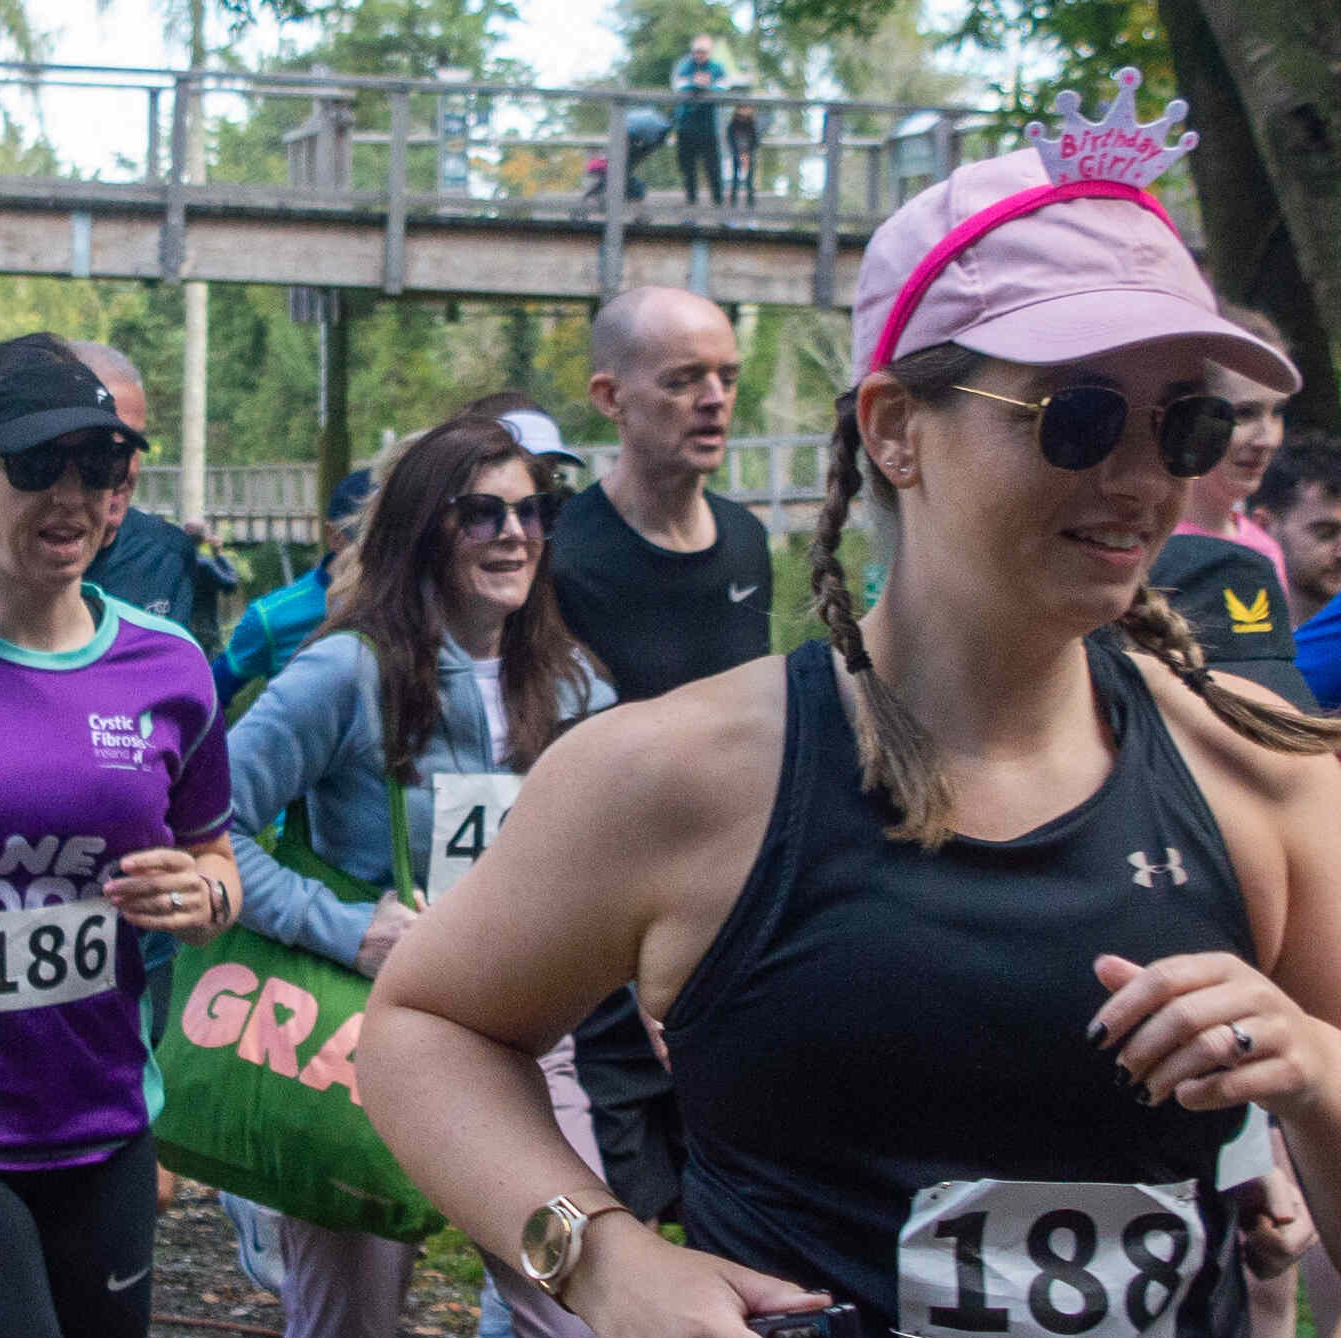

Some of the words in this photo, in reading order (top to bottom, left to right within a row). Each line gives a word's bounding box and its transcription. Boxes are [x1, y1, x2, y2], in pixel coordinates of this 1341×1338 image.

[1060, 128, 1163, 162] Birthday
[1078, 153, 1138, 179] Girl
[88, 714, 134, 731] Cystic
[929, 1208, 1190, 1335] 188
